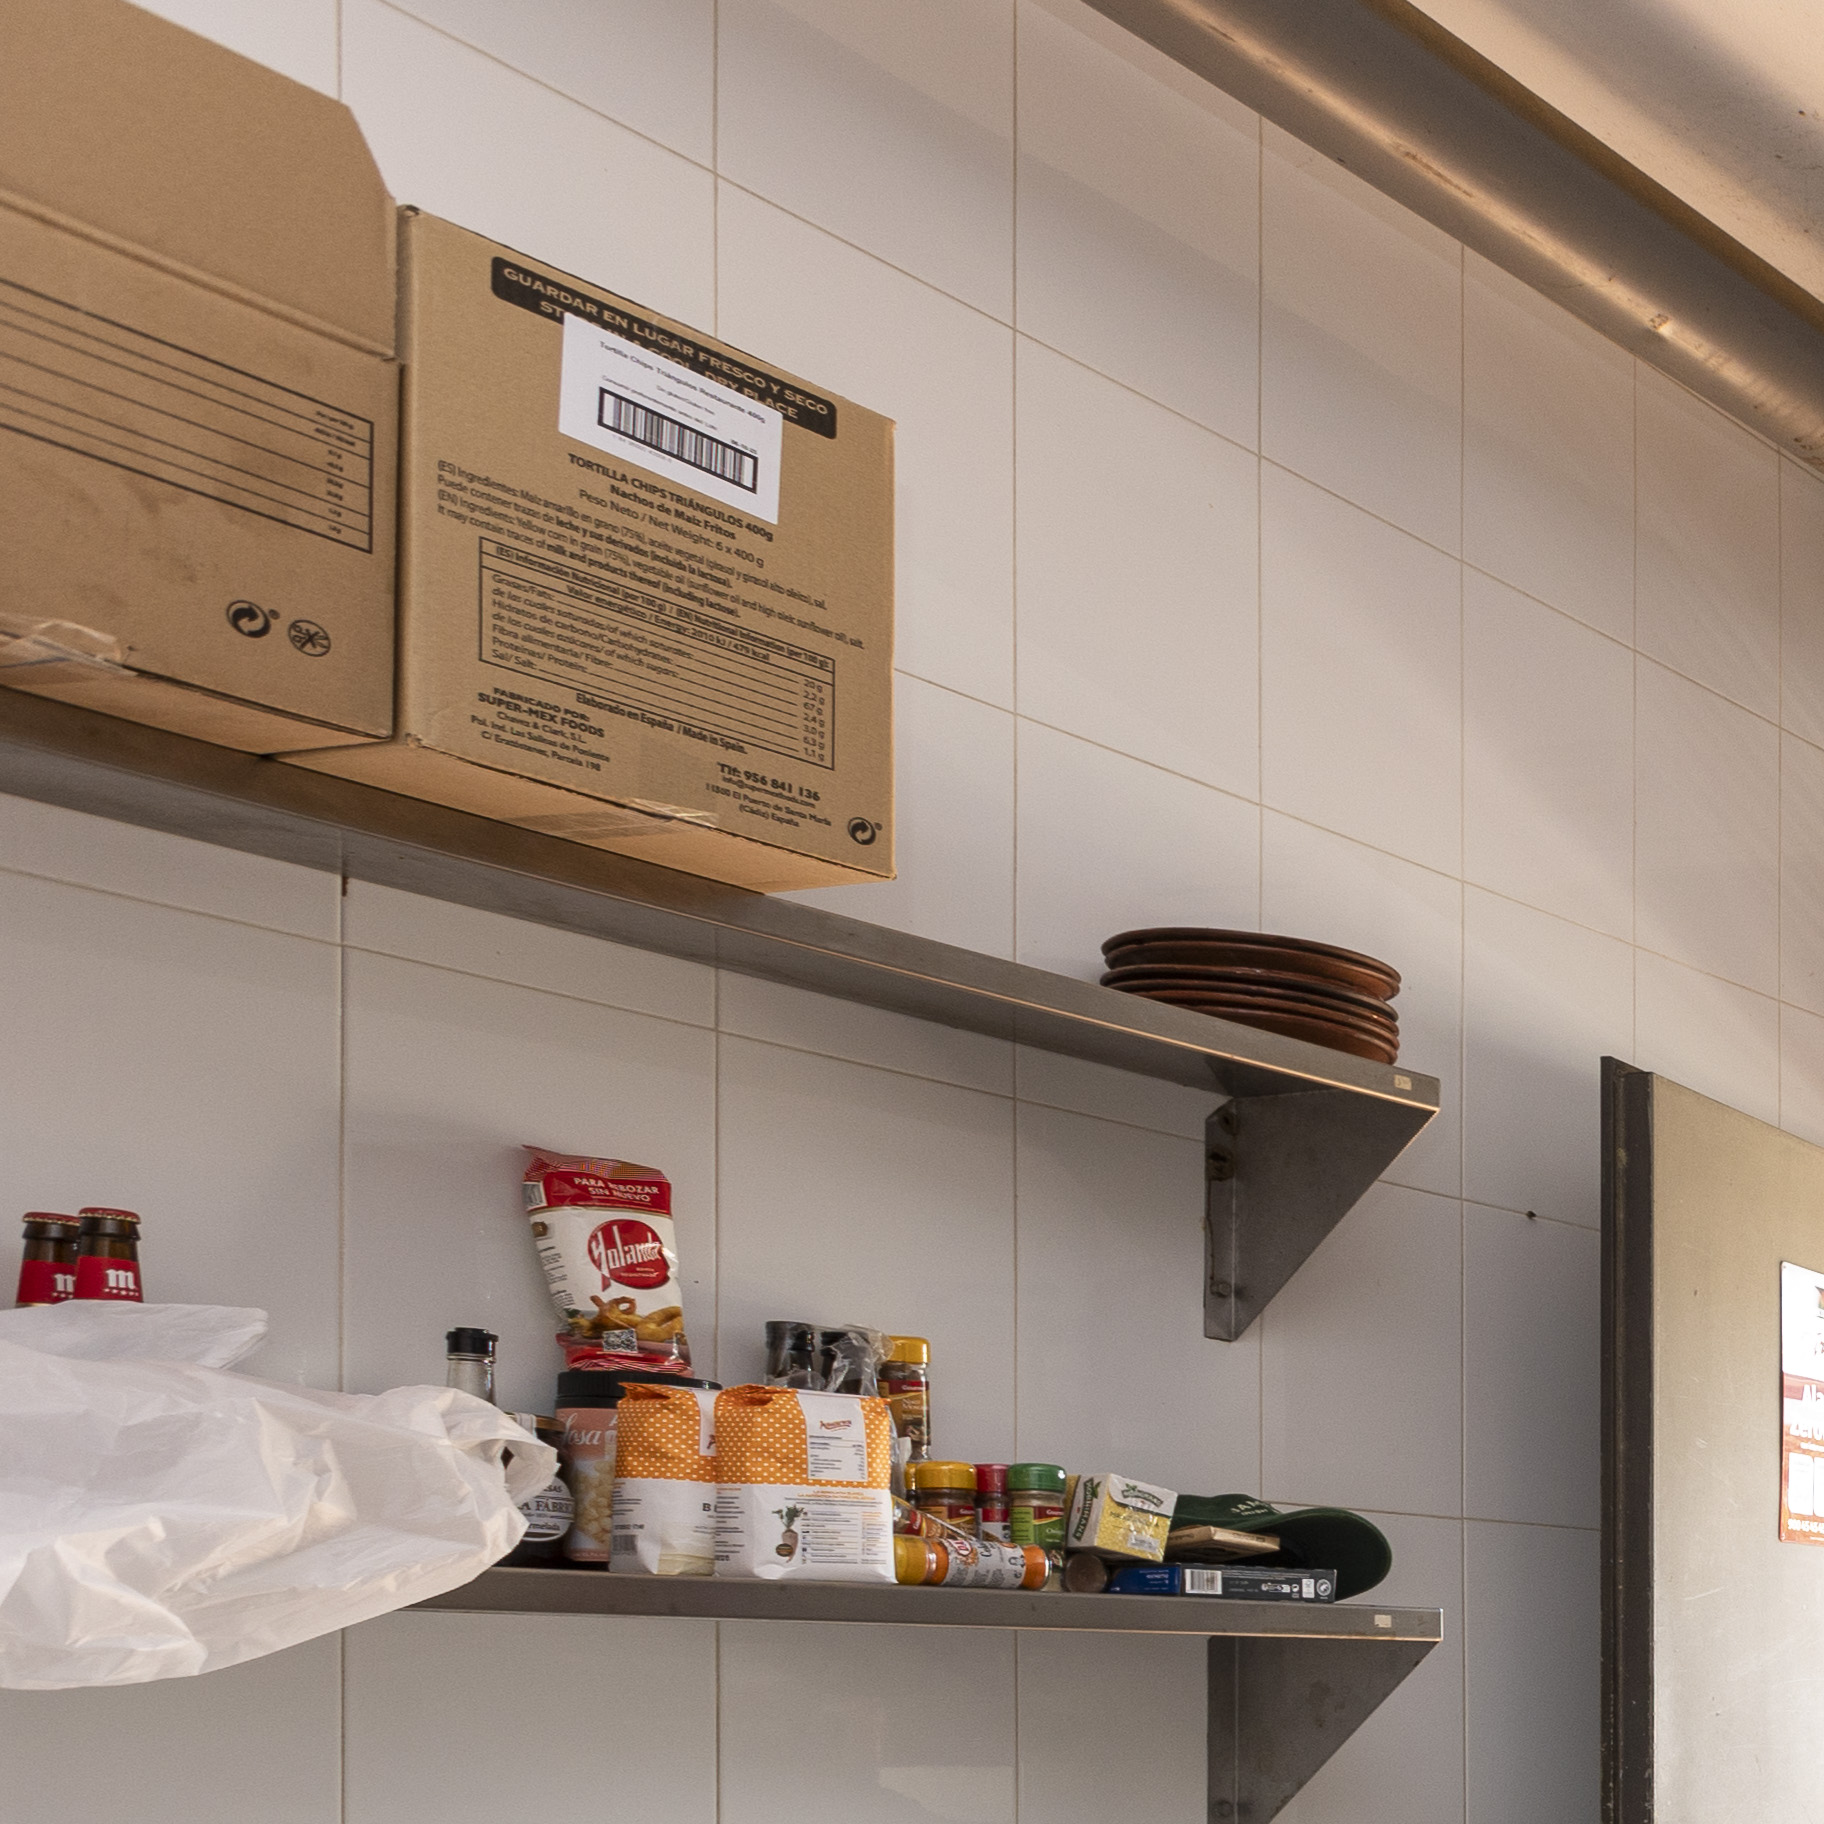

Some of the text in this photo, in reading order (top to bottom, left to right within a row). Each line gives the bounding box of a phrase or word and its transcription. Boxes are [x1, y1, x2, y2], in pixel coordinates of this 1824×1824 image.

[503, 265, 827, 417] GUARDAR EN LUGAR FRESCO Y SECO
[630, 354, 653, 372] Chips
[747, 409, 765, 425] 400g
[568, 452, 773, 542] TORTILLA CHIPS TRIÁNGULOS 400g
[610, 483, 735, 540] Nachos de Fritos
[579, 488, 607, 508] Peso
[610, 500, 639, 520] Neto
[648, 514, 668, 531] Net
[671, 523, 712, 549] Weight:
[715, 540, 723, 552] 6
[734, 547, 754, 563] 400
[756, 556, 764, 569] g
[477, 690, 604, 738] SUPER-MEX FOODS
[493, 686, 590, 723] FABRICADO POR:
[576, 692, 747, 756] Elaborado en España Made in Spain.
[743, 769, 767, 786] 956
[770, 778, 792, 794] 841
[798, 786, 820, 802] 136
[573, 1177, 605, 1189] PARA
[588, 1186, 610, 1197] SIN
